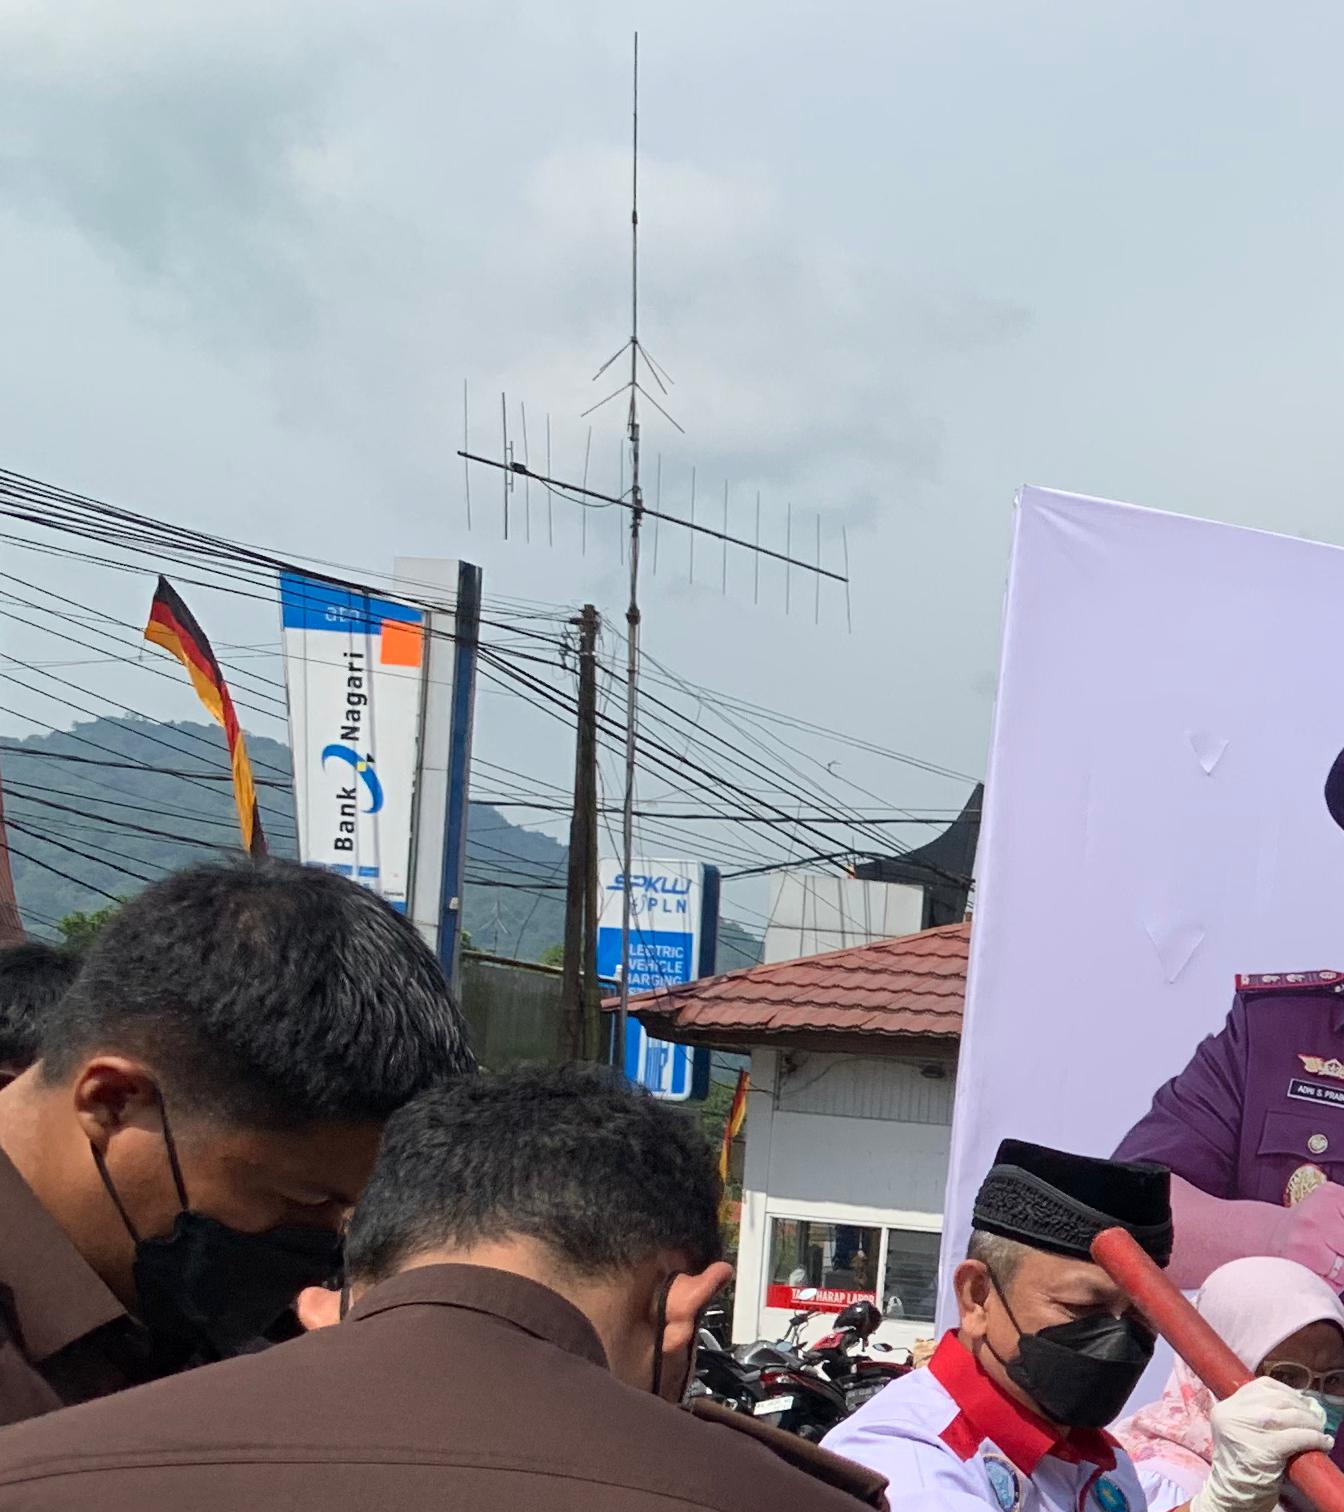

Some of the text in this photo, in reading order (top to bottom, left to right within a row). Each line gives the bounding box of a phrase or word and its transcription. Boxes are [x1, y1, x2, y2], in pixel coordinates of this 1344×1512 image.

[334, 652, 368, 852] Bank Nagari
[648, 897, 687, 913] PLN
[629, 943, 684, 959] LECTRIC
[629, 958, 683, 974] VEHICLE
